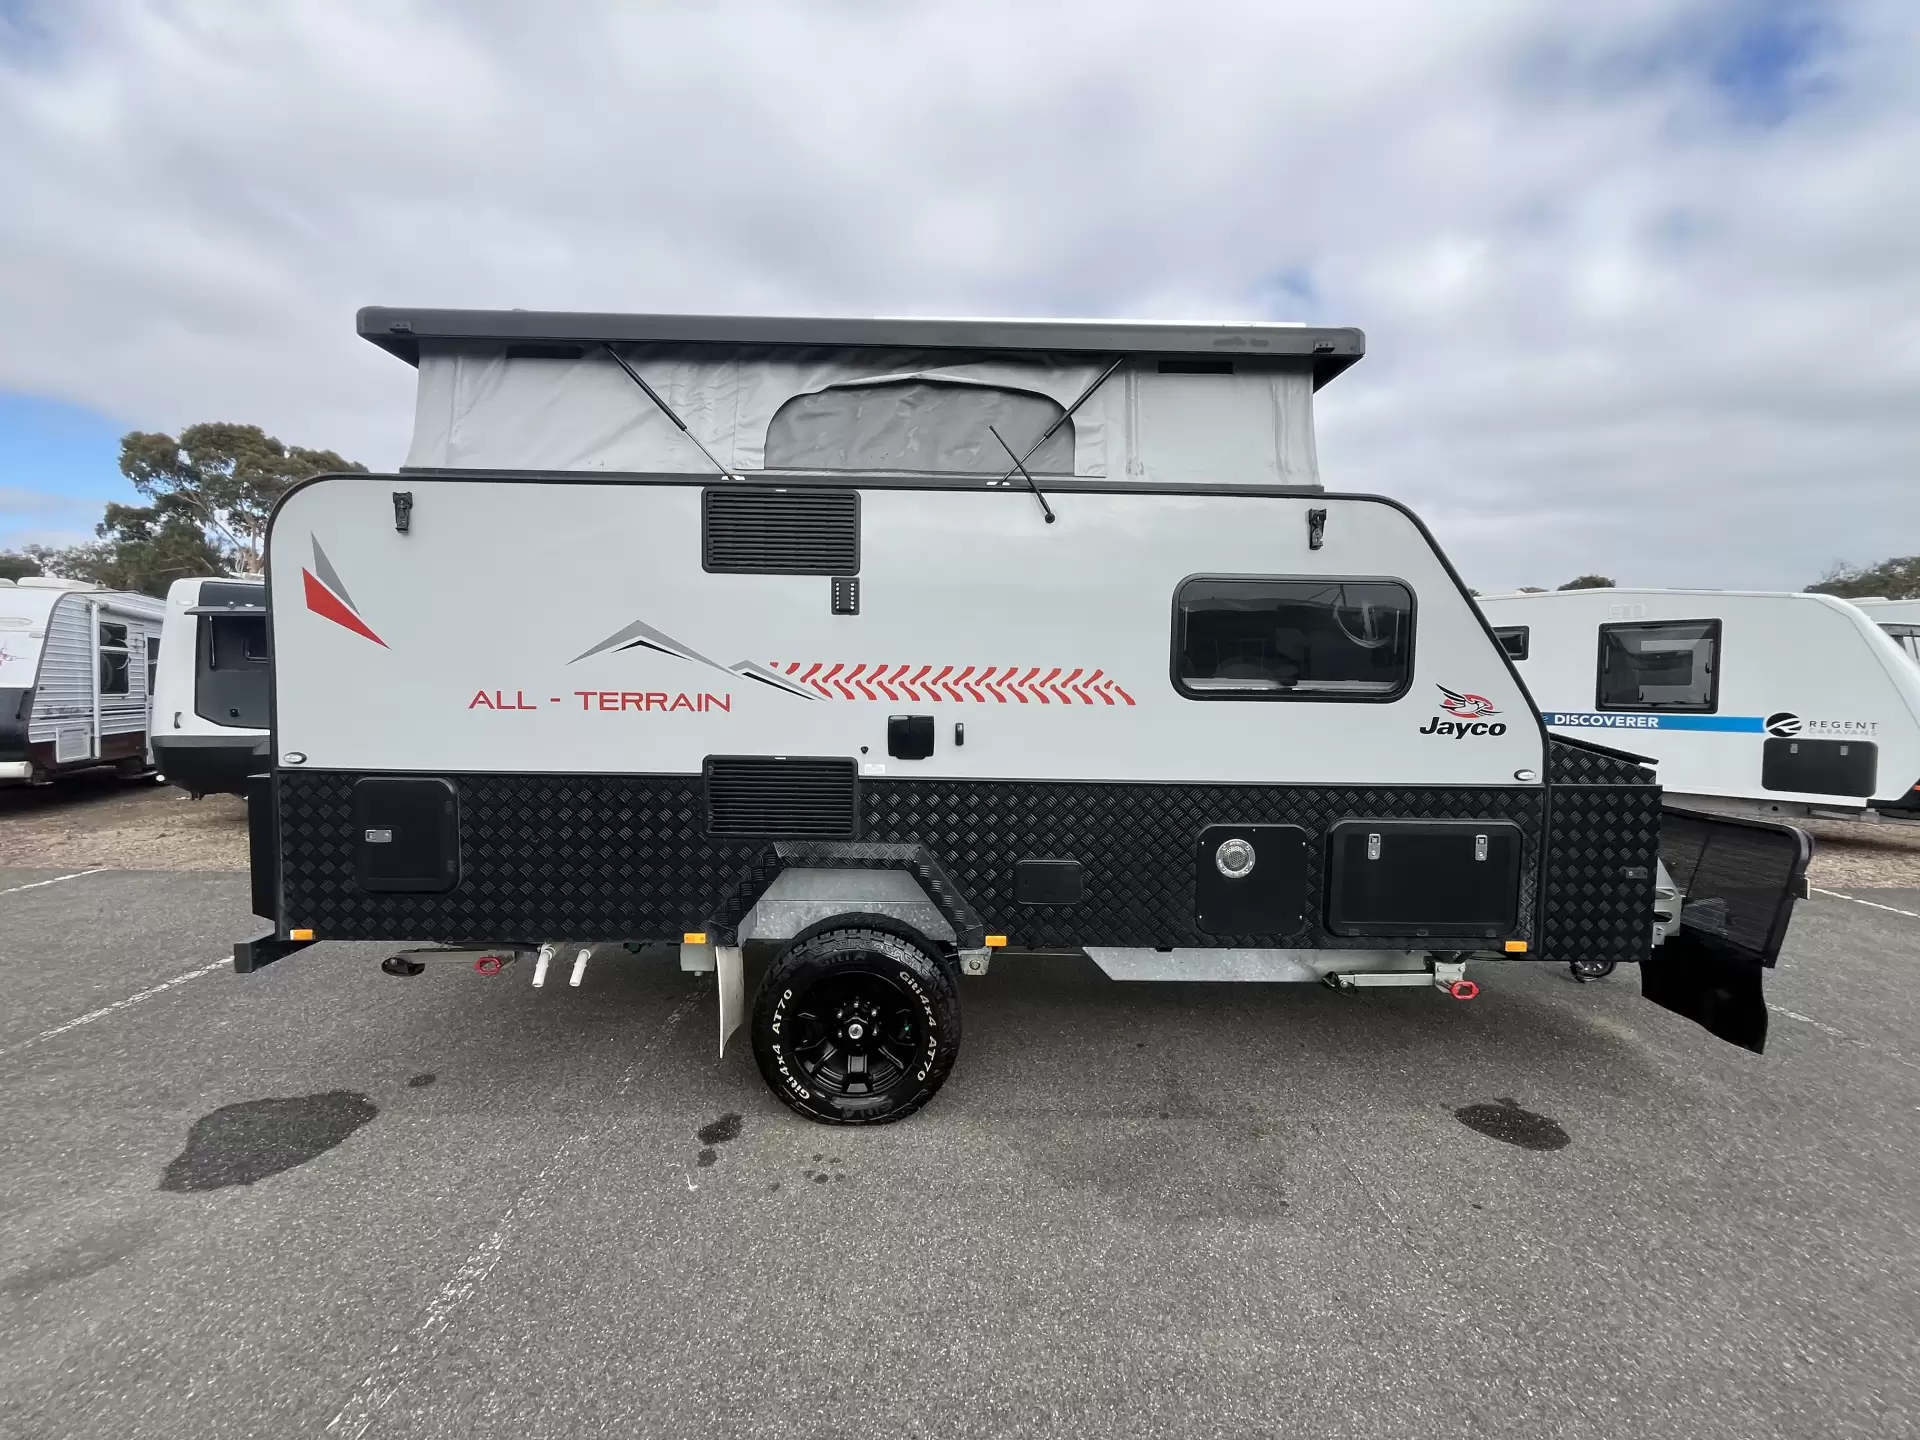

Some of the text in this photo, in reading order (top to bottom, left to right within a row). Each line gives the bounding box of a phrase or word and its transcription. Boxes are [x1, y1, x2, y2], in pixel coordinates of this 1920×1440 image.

[468, 690, 537, 710] ALL
[574, 691, 731, 712] TERRAIN
[1420, 717, 1507, 739] Jayco
[1554, 714, 1659, 728] DISCOVERER
[1808, 727, 1877, 737] CARAVANS
[1809, 720, 1878, 730] REGENT
[772, 989, 793, 1035] AT70
[917, 1035, 937, 1081] AT70
